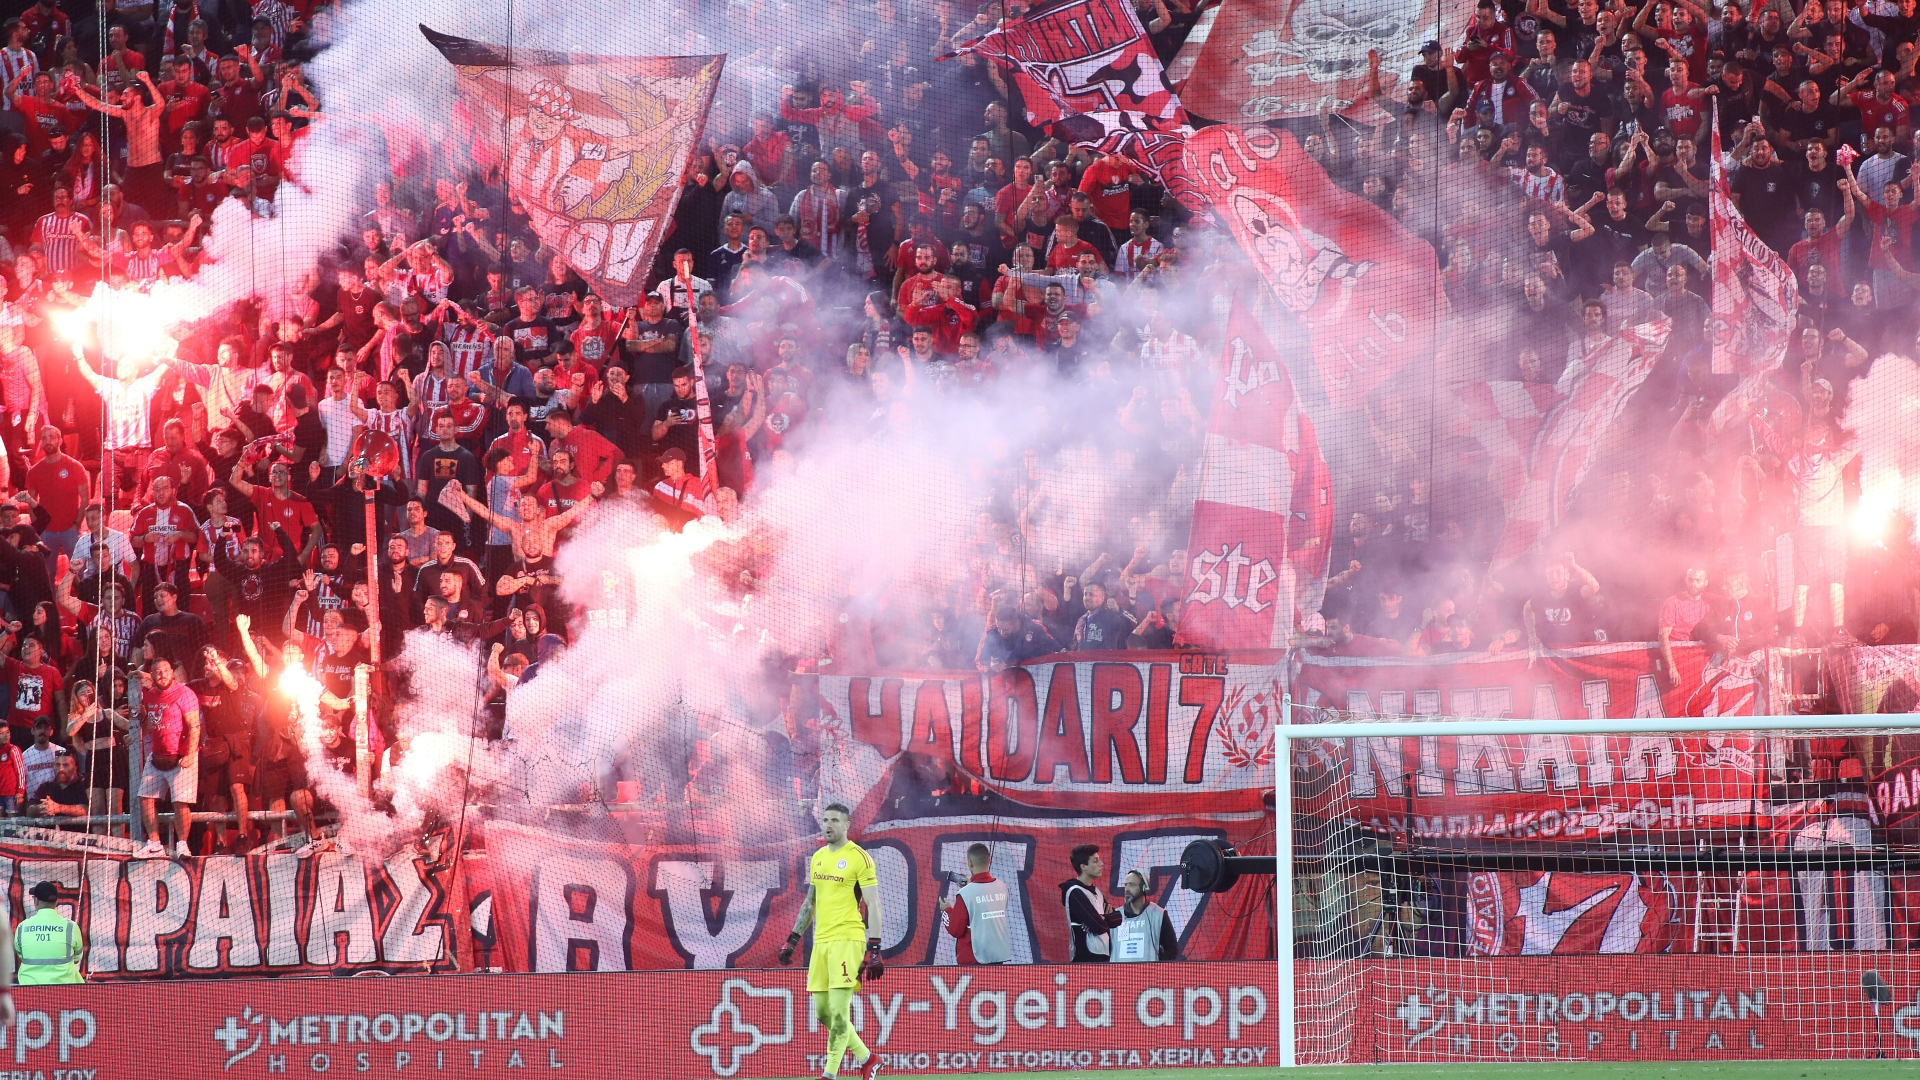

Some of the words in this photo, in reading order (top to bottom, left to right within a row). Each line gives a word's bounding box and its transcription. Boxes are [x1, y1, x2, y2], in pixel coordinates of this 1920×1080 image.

[1179, 653, 1229, 675] GATE
[1179, 675, 1225, 784] 7
[812, 872, 845, 883] Stoiximan
[975, 894, 994, 903] BALL
[30, 925, 64, 933] BRINKS
[1125, 920, 1146, 928] TAFF
[35, 933, 51, 942] 701
[841, 961, 849, 977] 1
[1136, 985, 1267, 1040] app
[1453, 990, 1766, 1025] METROPOLITAN
[268, 1009, 564, 1046] METROPOLITAN
[1453, 1030, 1765, 1053] HOSPITAL
[268, 1048, 562, 1073] HOSPITAL
[843, 1053, 930, 1071] ΙΑΡΙΚΟ
